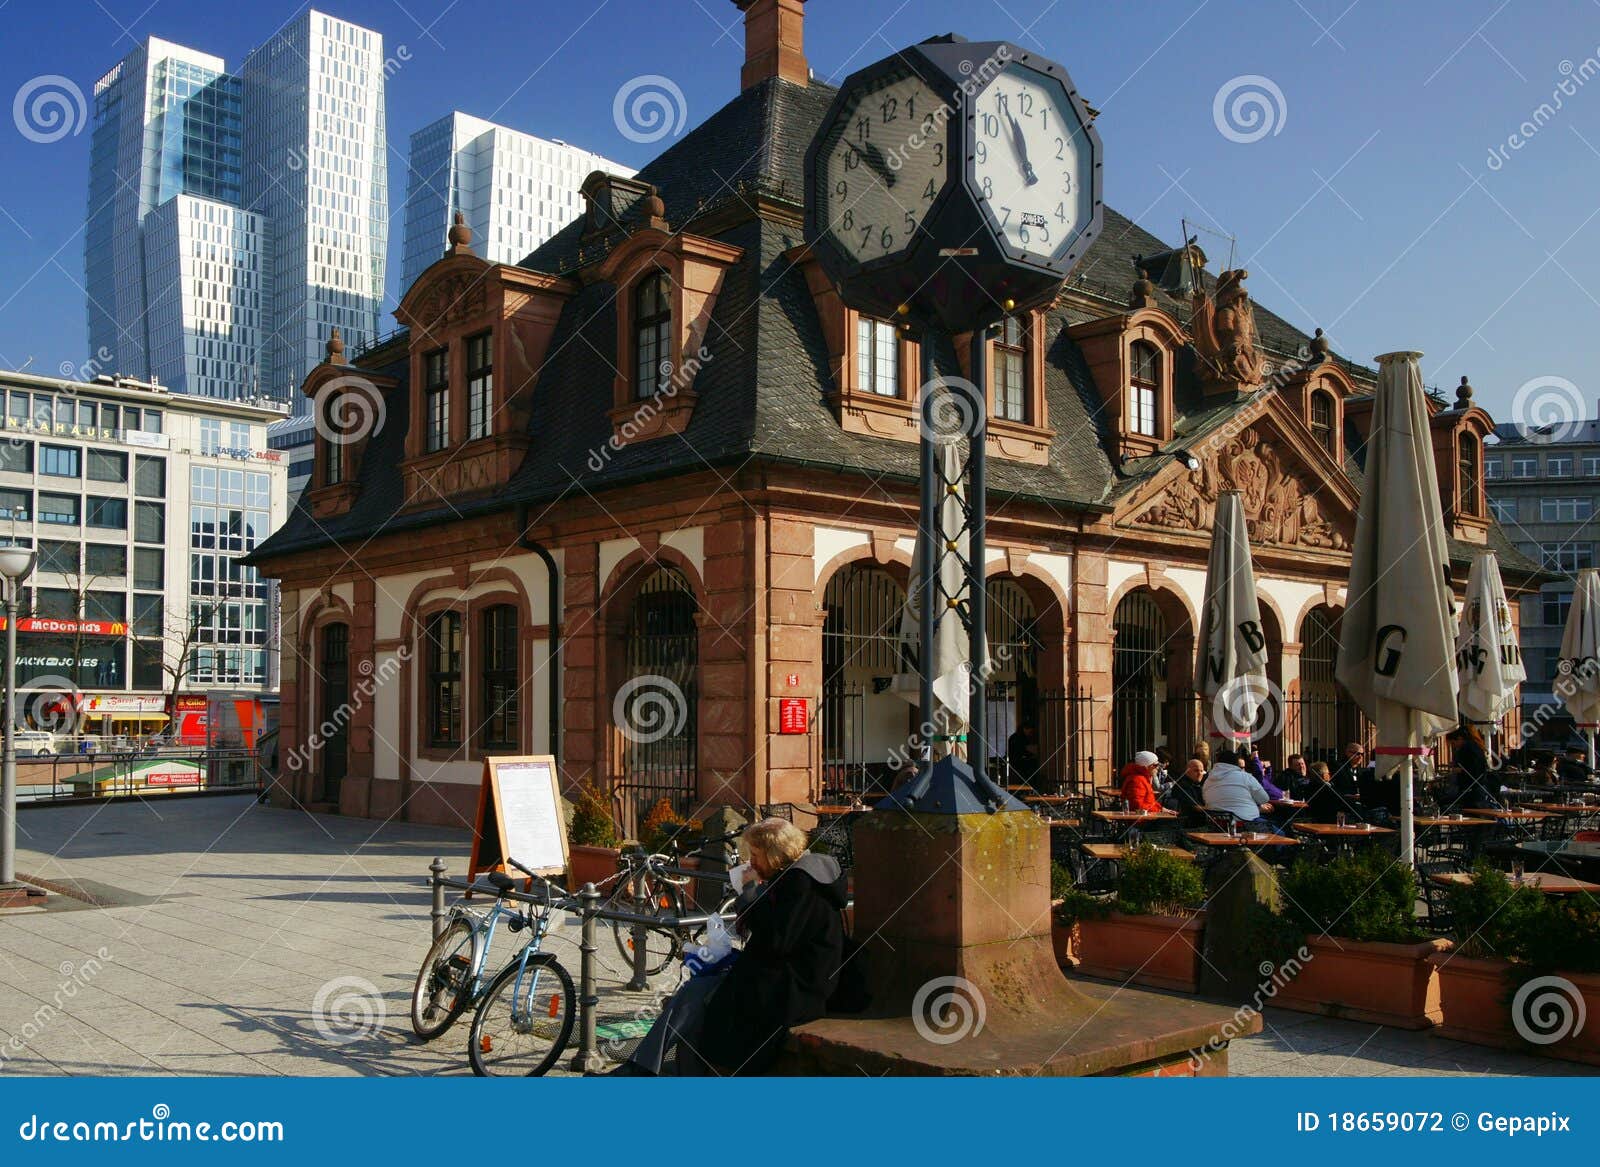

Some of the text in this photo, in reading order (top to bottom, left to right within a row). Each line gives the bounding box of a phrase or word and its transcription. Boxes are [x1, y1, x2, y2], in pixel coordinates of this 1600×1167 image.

[879, 97, 898, 123] 12
[905, 96, 915, 120] 1
[1017, 92, 1033, 117] 12
[855, 118, 870, 141] 11
[980, 112, 999, 138] 10
[1039, 108, 1048, 130] 1
[841, 148, 860, 173] 10
[932, 142, 944, 167] 3
[976, 141, 987, 164] 9
[1055, 137, 1064, 161] 2
[836, 180, 848, 204] 9
[922, 178, 937, 202] 4
[982, 176, 994, 200] 8
[1062, 171, 1071, 195] 3
[842, 208, 854, 231] 8
[904, 210, 917, 235] 5
[1001, 206, 1011, 228] 7
[1054, 202, 1065, 224] 4
[860, 226, 872, 249] 7
[881, 226, 893, 249] 6
[1375, 624, 1408, 678] G
[789, 675, 797, 686] 15
